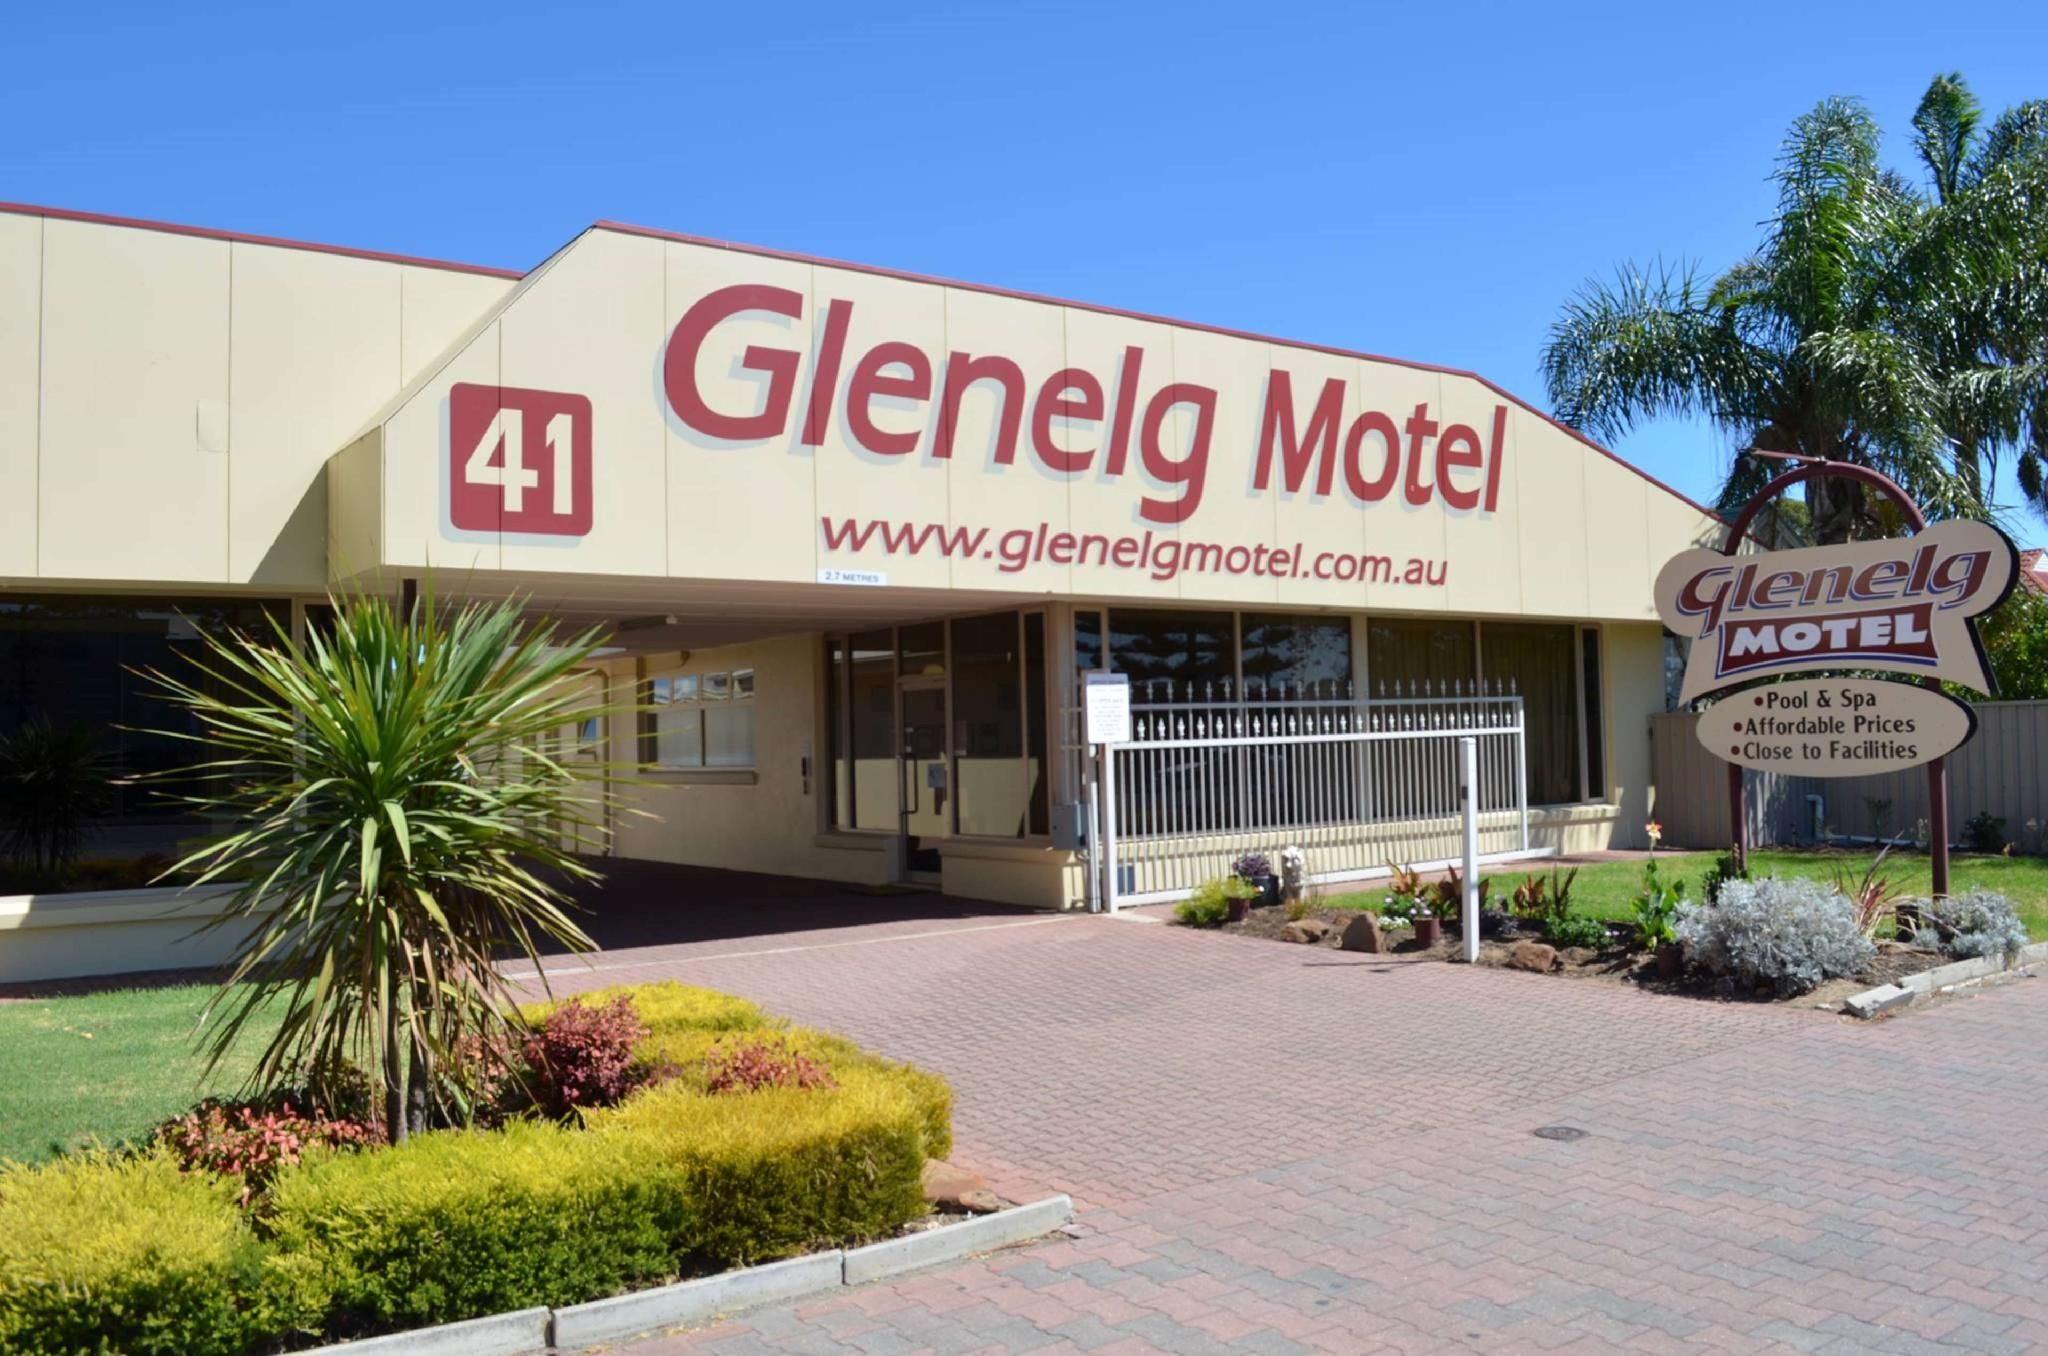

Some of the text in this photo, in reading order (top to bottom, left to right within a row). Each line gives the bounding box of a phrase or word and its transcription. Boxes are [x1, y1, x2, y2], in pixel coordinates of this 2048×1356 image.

[664, 284, 1507, 523] Glenelg Motel
[465, 407, 573, 515] 41
[822, 516, 1448, 586] www.glenelgmotel.com.au
[825, 571, 879, 582] 2.7 METRES
[1677, 544, 1992, 640] Glenelg
[1728, 613, 1928, 656] MOTEL
[1767, 689, 1876, 711] Pool & Spa
[1744, 715, 1915, 736] Affordable Prices
[1744, 740, 1918, 760] Close to Facilities
